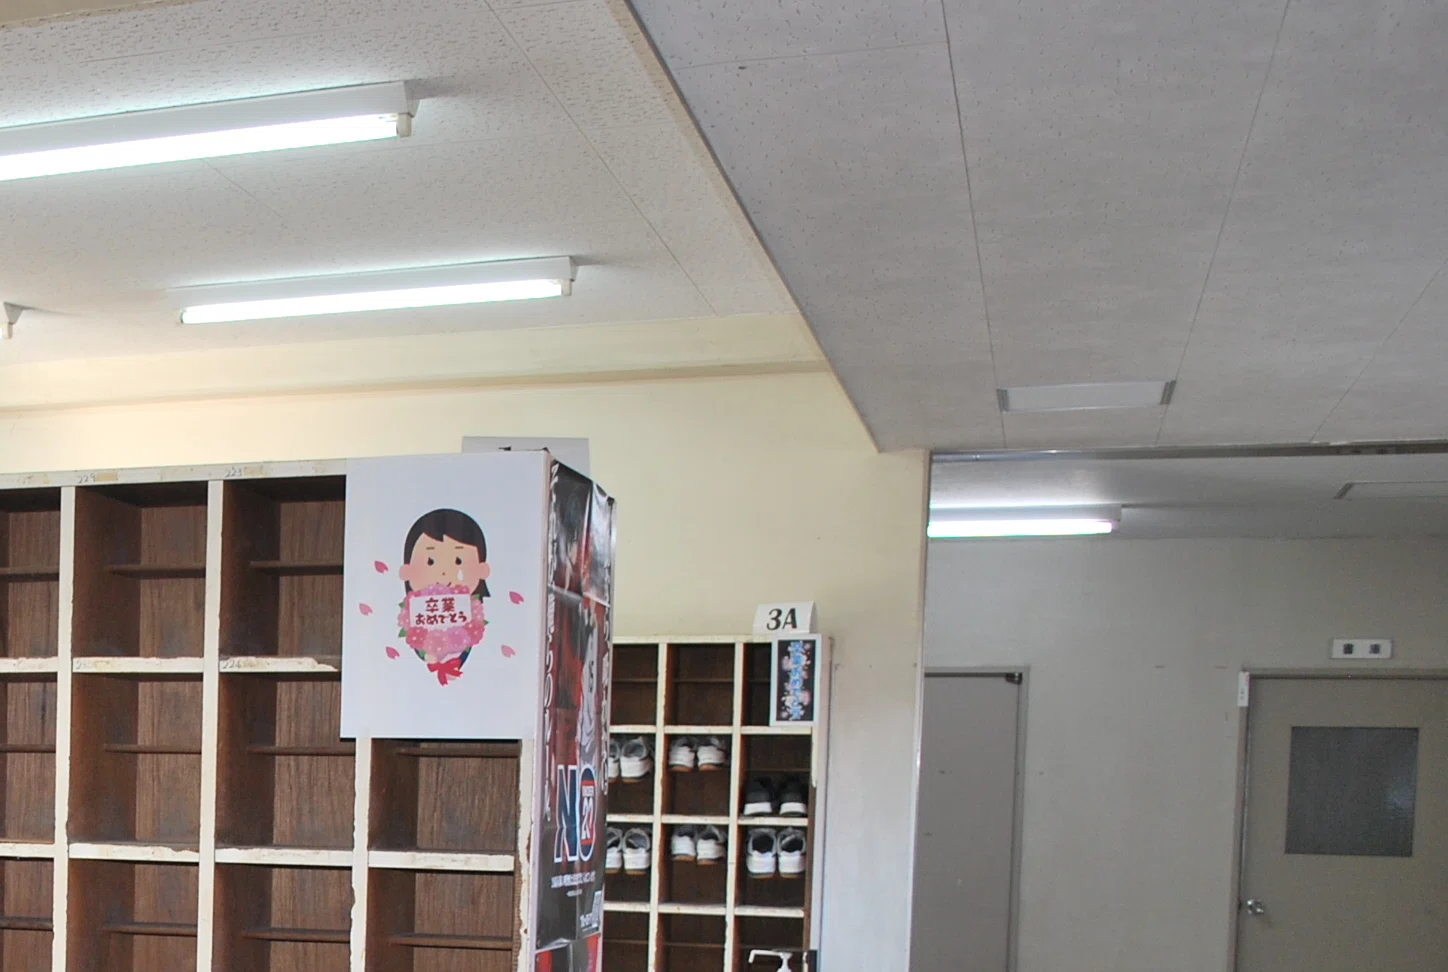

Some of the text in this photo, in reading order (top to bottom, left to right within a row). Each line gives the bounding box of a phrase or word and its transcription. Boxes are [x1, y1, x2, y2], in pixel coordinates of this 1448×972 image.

[425, 597, 455, 613] 卒業
[415, 611, 467, 625] おめでとう
[766, 607, 798, 631] 3A
